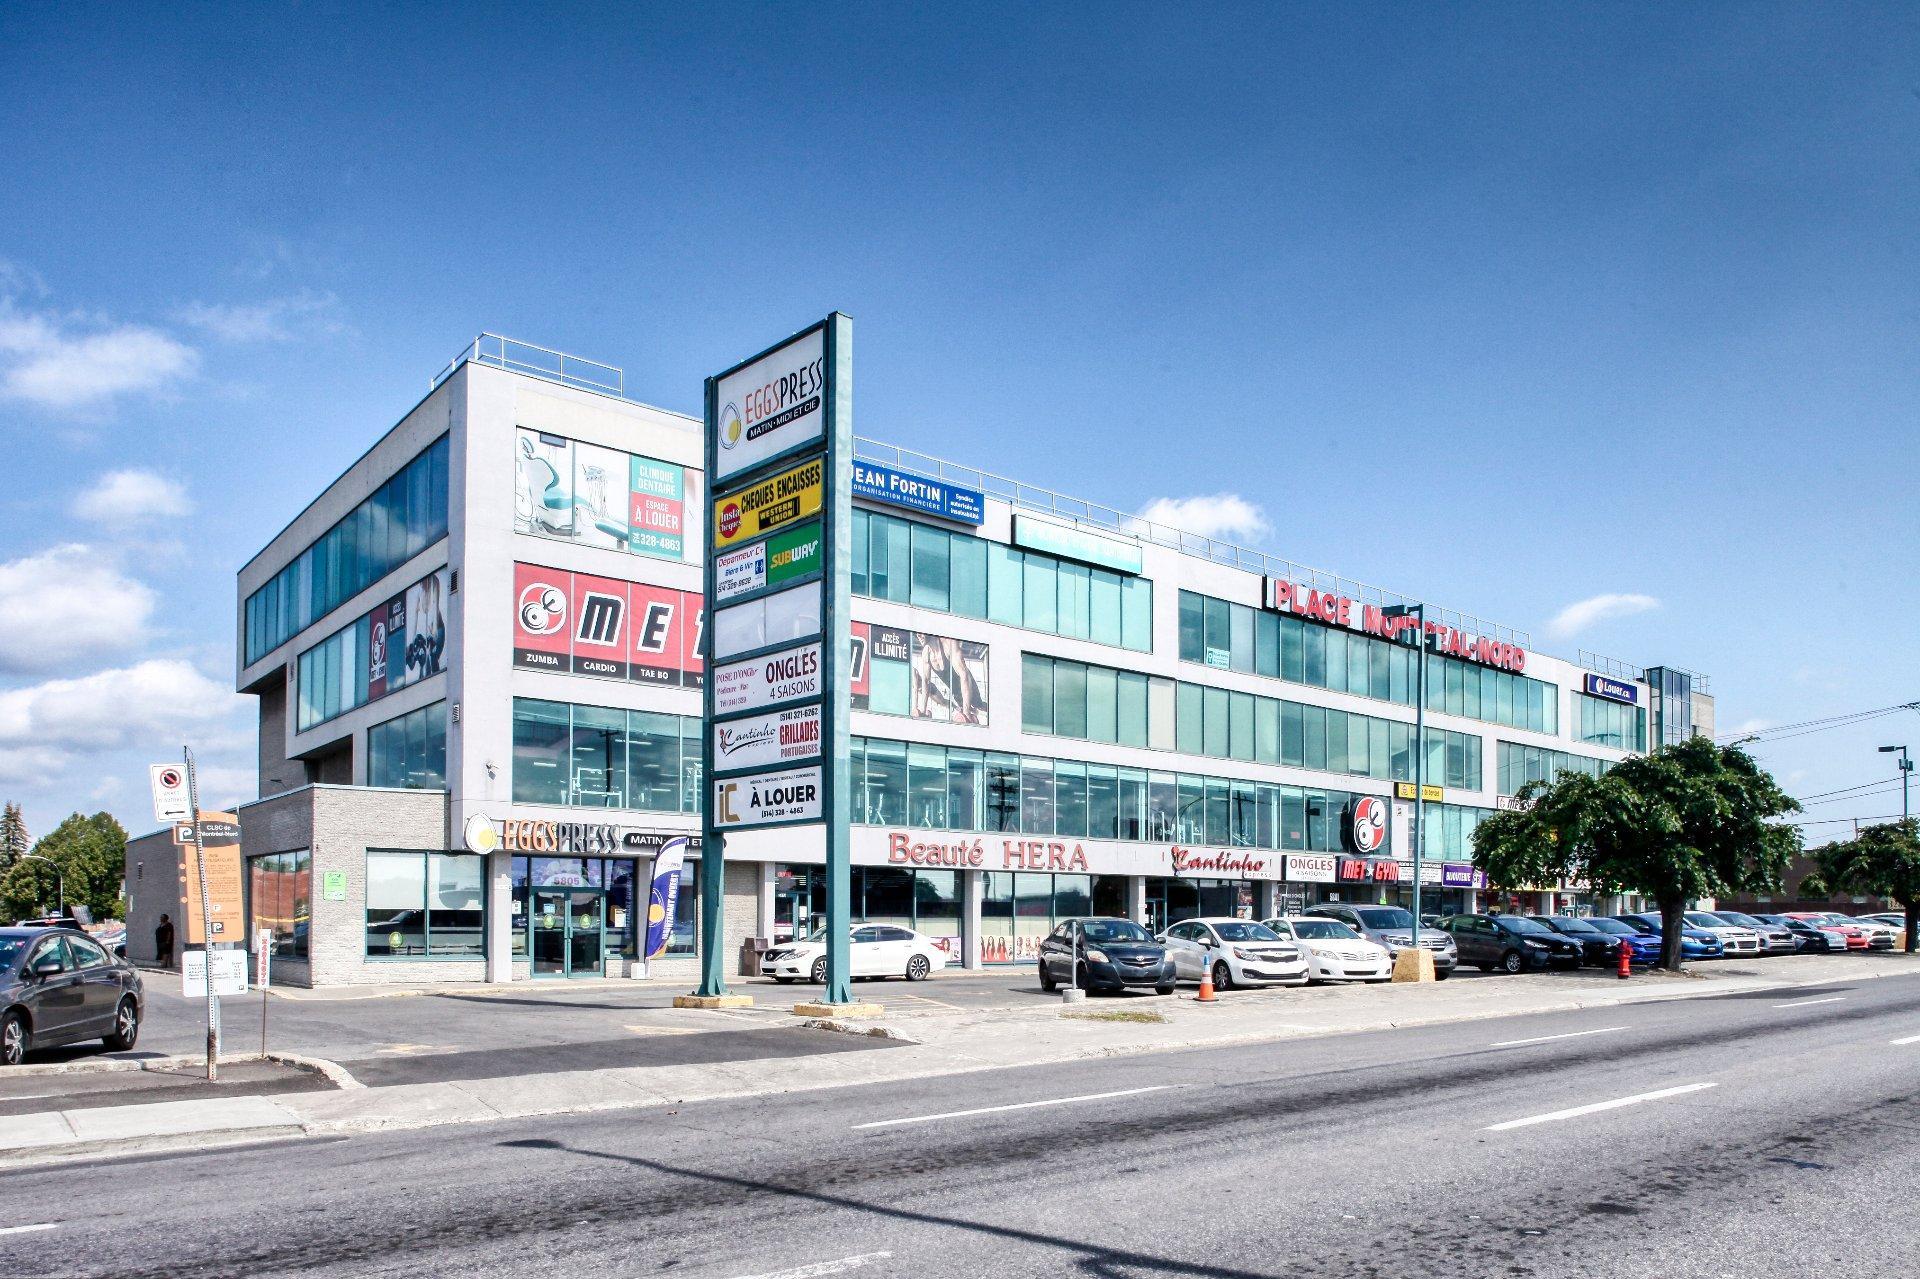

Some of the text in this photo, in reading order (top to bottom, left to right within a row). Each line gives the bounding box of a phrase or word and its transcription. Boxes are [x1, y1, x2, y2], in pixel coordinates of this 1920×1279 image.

[746, 357, 822, 424] EGGSPRESS
[793, 407, 804, 419] ET
[804, 401, 816, 413] CIE
[640, 466, 675, 483] CLINIQUE
[638, 478, 676, 496] DENTAIRE
[890, 474, 941, 502] FORTIN
[645, 500, 669, 513] ESPACE
[853, 484, 941, 511] ORGANISATION FINANCIÈRE
[635, 505, 679, 530] À LOUER
[720, 508, 741, 523] Insta
[760, 500, 793, 520] WESTERN
[770, 509, 793, 524] UNION
[640, 533, 681, 552] 328-4863
[770, 540, 819, 569] SUBWAY
[1273, 579, 1352, 627] PLACE
[882, 633, 900, 644] ACCÈS
[526, 653, 559, 666] ZUMBA
[875, 642, 908, 659] ILLIMITÉ
[583, 661, 617, 673] CARDIO
[640, 669, 669, 680] TAE BO
[765, 651, 818, 684] ONGLES
[769, 687, 776, 700] 4
[777, 678, 815, 699] SAISONS
[724, 723, 776, 747] Cantinho
[779, 720, 819, 746] GRILLADES
[780, 743, 818, 758] PORTUGAISES
[750, 785, 816, 808] À LOUER
[761, 809, 774, 819] (514)
[775, 808, 785, 816] 328
[789, 807, 804, 815] 4863
[503, 819, 621, 854] EGGSPRESS
[630, 835, 663, 845] MATIN
[888, 832, 1089, 872] Beauté HERA
[1173, 848, 1265, 872] Cantinho
[1290, 859, 1333, 871] ONGLES
[1342, 860, 1367, 879] MET
[1374, 861, 1399, 881] GYM
